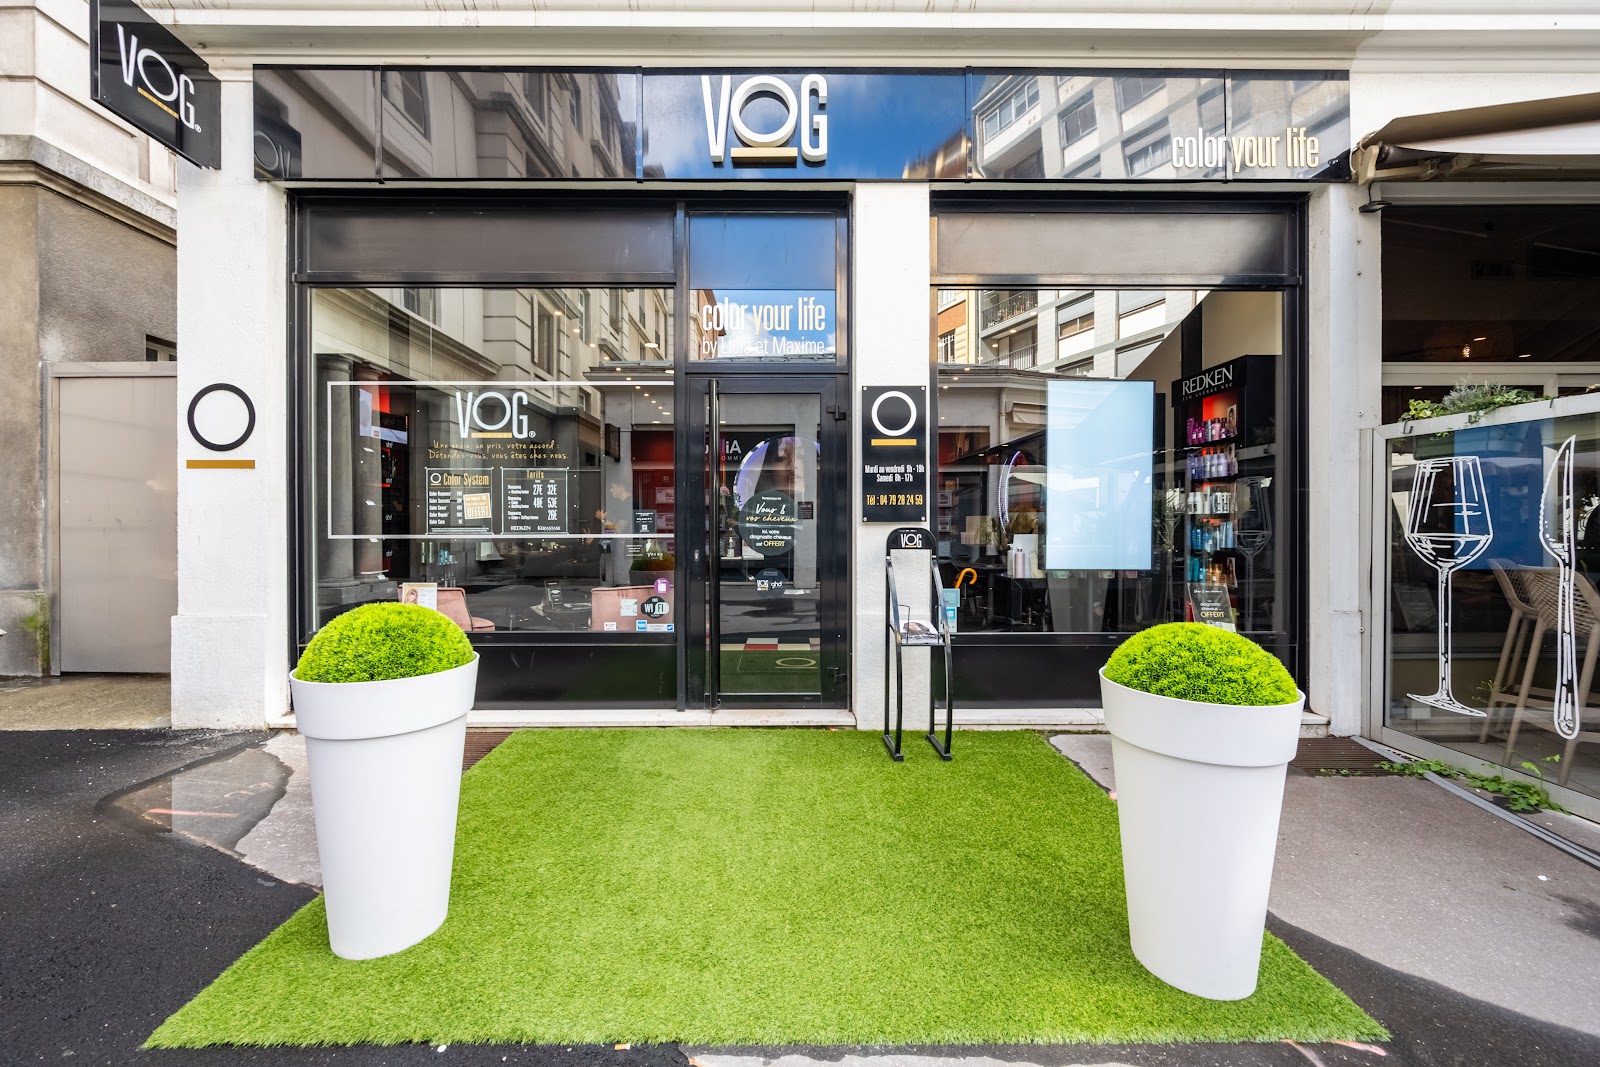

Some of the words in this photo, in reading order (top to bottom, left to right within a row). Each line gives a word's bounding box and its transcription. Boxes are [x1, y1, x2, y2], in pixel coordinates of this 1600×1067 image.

[701, 74, 828, 162] VOG
[1172, 128, 1227, 168] color
[1232, 136, 1280, 173] your
[1286, 127, 1320, 168] life
[702, 296, 748, 331] color
[752, 304, 793, 336] your
[798, 296, 826, 331] life
[702, 337, 718, 358] by
[755, 339, 769, 355] et
[772, 336, 825, 355] Maxime
[1182, 364, 1232, 396] REDKEN
[433, 440, 448, 449] Une
[487, 442, 504, 453] prix,
[529, 440, 555, 450] accord
[510, 451, 527, 460] êtes
[530, 449, 548, 460] chez
[550, 452, 569, 460] nous.
[526, 470, 544, 478] Tarifs
[864, 464, 878, 474] Mardi
[886, 464, 904, 474] vendredi
[443, 472, 462, 486] Color
[463, 472, 490, 487] System
[876, 474, 894, 482] Samedi
[532, 484, 544, 496] 27€
[547, 484, 558, 496] 32€
[866, 494, 876, 506] Tél
[880, 494, 887, 506] 04
[889, 494, 896, 506] 79
[906, 494, 914, 506] 24
[466, 505, 490, 518] OFFERT
[756, 502, 778, 514] Vous
[762, 513, 798, 522] cheveux
[900, 534, 922, 548] VOG
[770, 580, 782, 589] ghd
